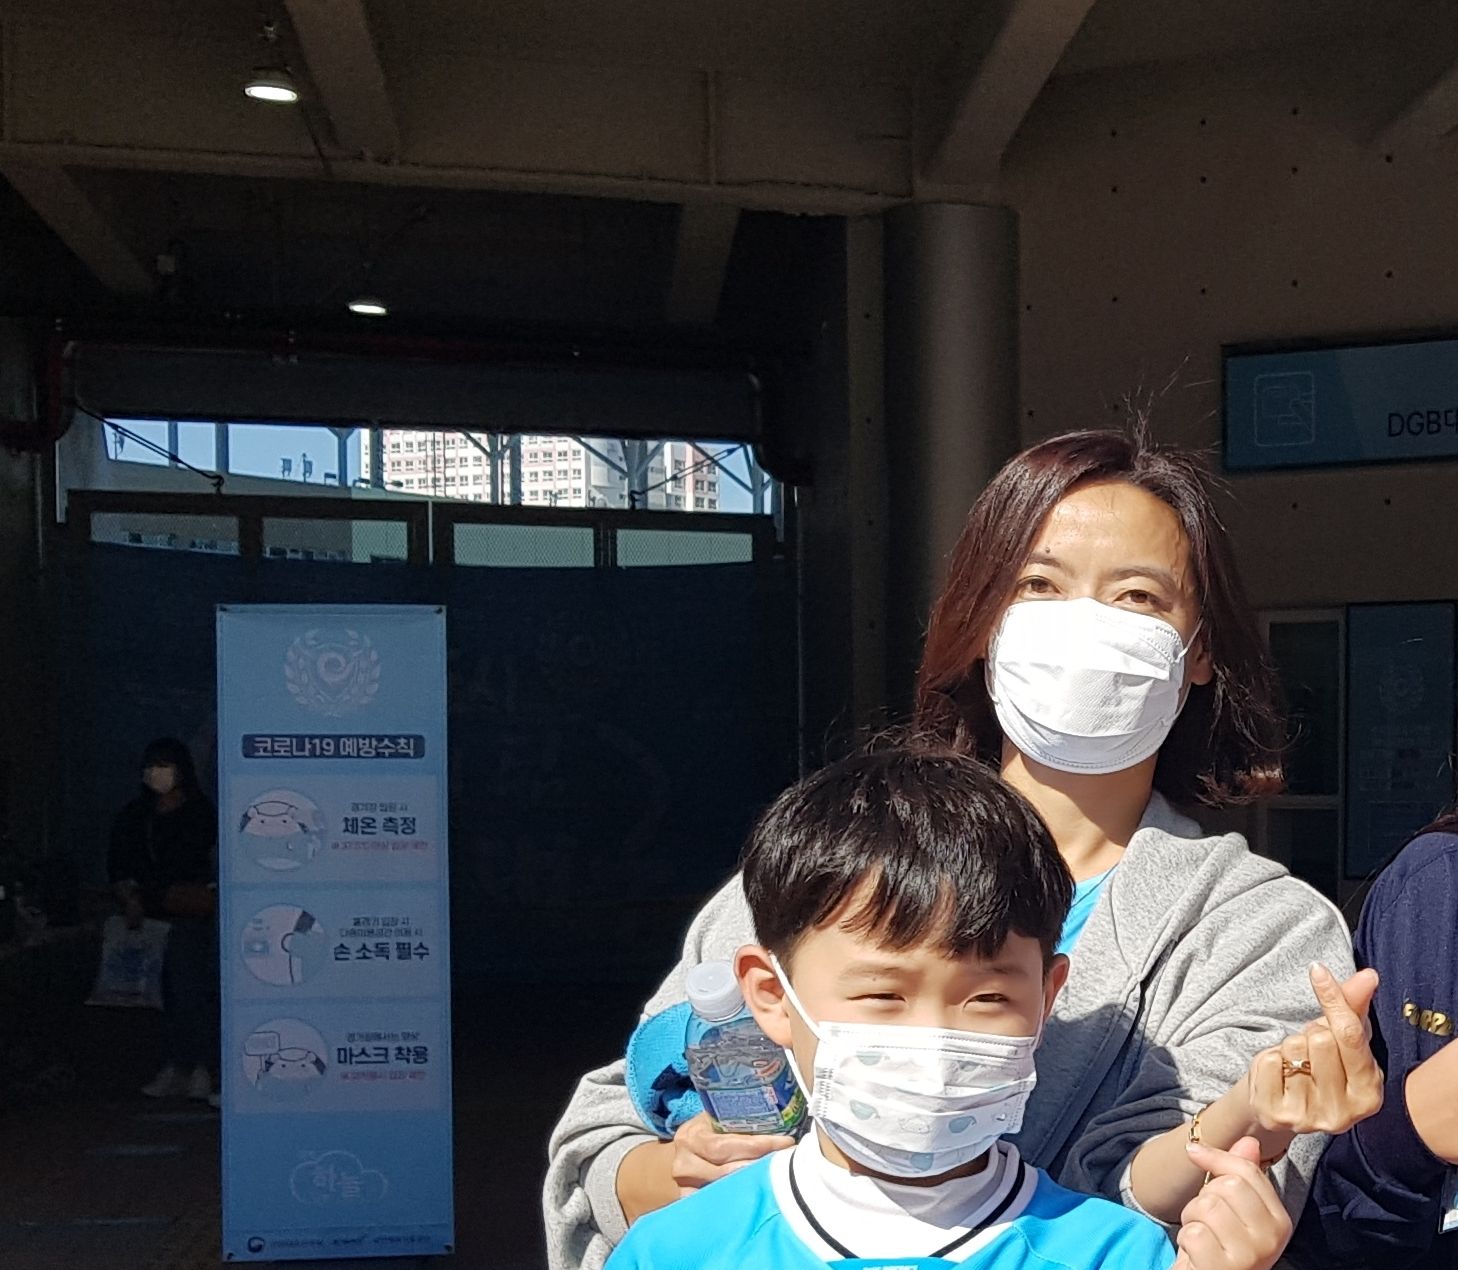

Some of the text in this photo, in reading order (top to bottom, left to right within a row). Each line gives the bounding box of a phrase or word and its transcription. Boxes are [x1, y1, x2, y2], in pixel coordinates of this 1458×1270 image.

[254, 736, 414, 757] 코로나19 예방수칙
[342, 816, 416, 836] 체온 측정
[333, 942, 430, 961] 손 소독 필수
[337, 1046, 429, 1065] 마스크 착용
